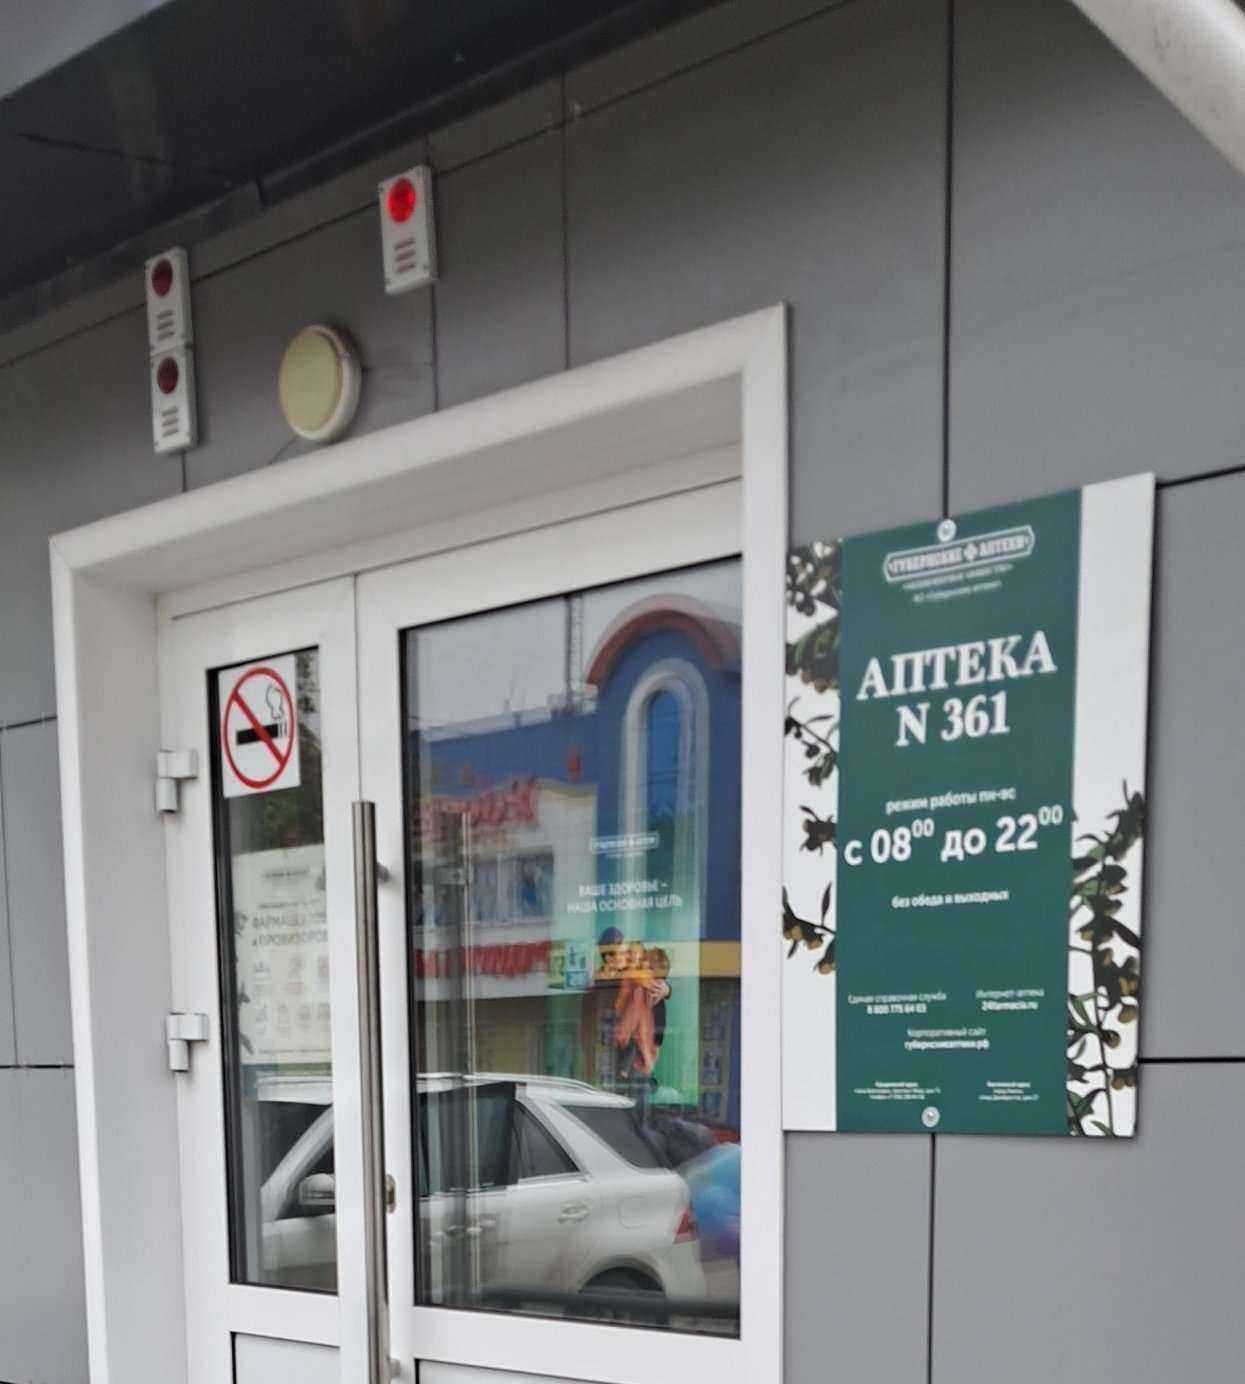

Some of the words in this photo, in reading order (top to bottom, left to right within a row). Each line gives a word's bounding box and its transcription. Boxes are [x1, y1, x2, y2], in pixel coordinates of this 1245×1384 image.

[856, 630, 1058, 701] АПТЕКА
[896, 704, 930, 747] N
[941, 691, 1010, 742] 361
[886, 794, 928, 816] режим
[931, 788, 977, 811] работы
[979, 786, 1017, 804] пн-вс
[940, 827, 987, 863] до
[891, 893, 910, 909] без
[912, 891, 943, 908] обеда
[945, 893, 953, 905] и
[953, 887, 1010, 905] выходных
